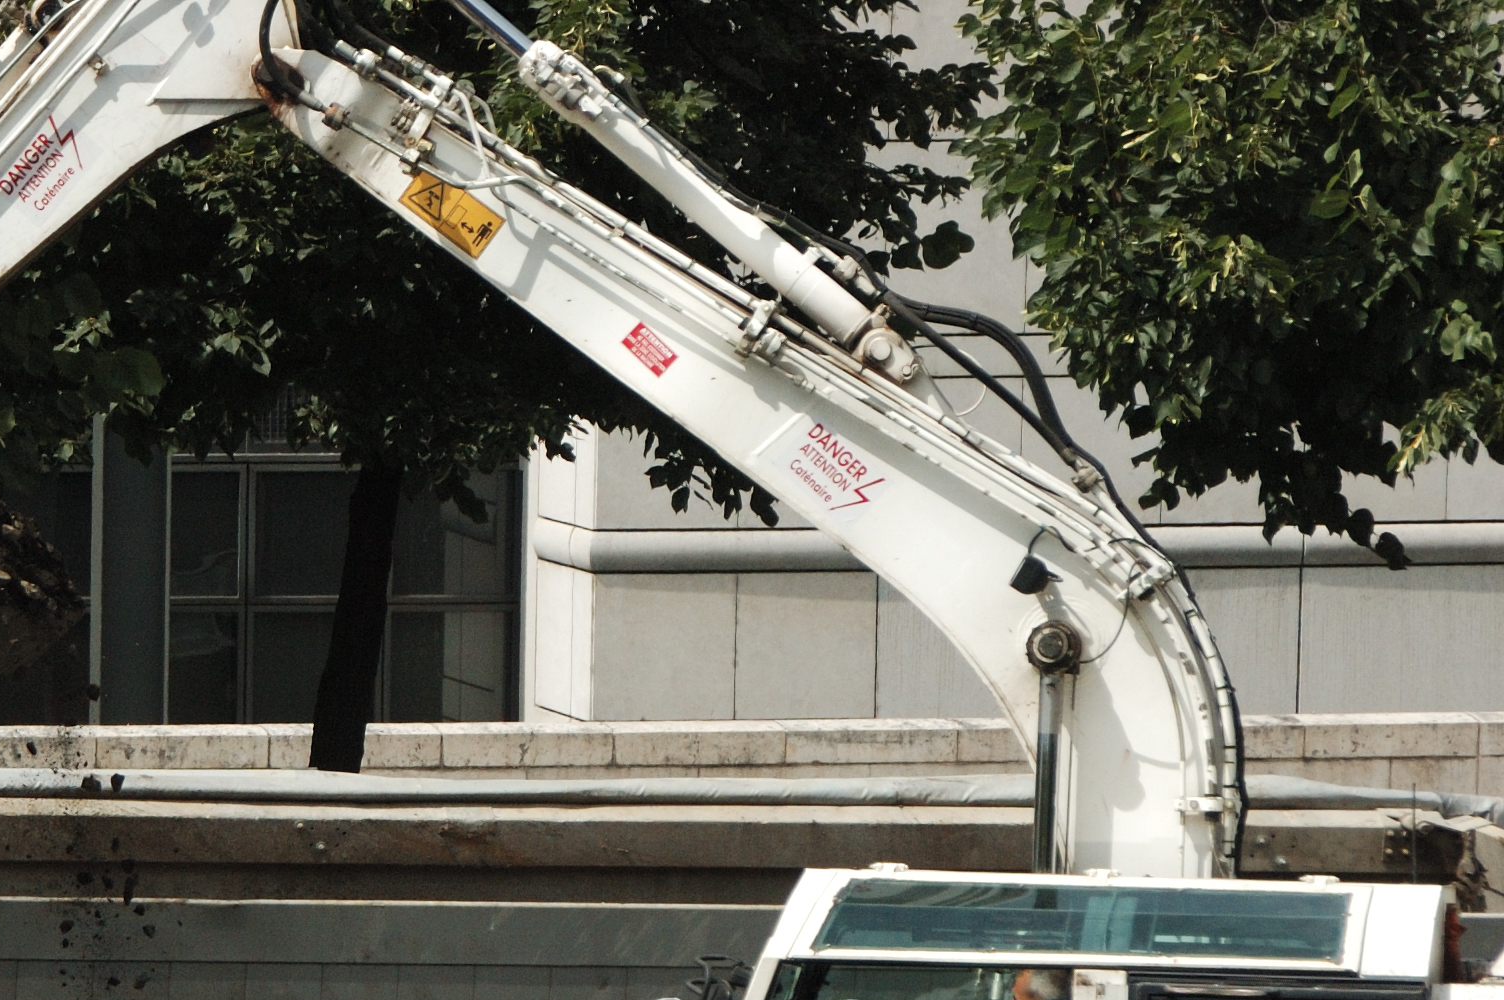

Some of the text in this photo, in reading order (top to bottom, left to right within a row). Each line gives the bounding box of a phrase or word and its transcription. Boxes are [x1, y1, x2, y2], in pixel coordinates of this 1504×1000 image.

[18, 148, 64, 203] ATTENTION
[34, 167, 75, 211] Caténaire
[799, 443, 851, 492] ATTENTION
[808, 423, 867, 482] DANGER
[790, 459, 832, 502] Caténaire
